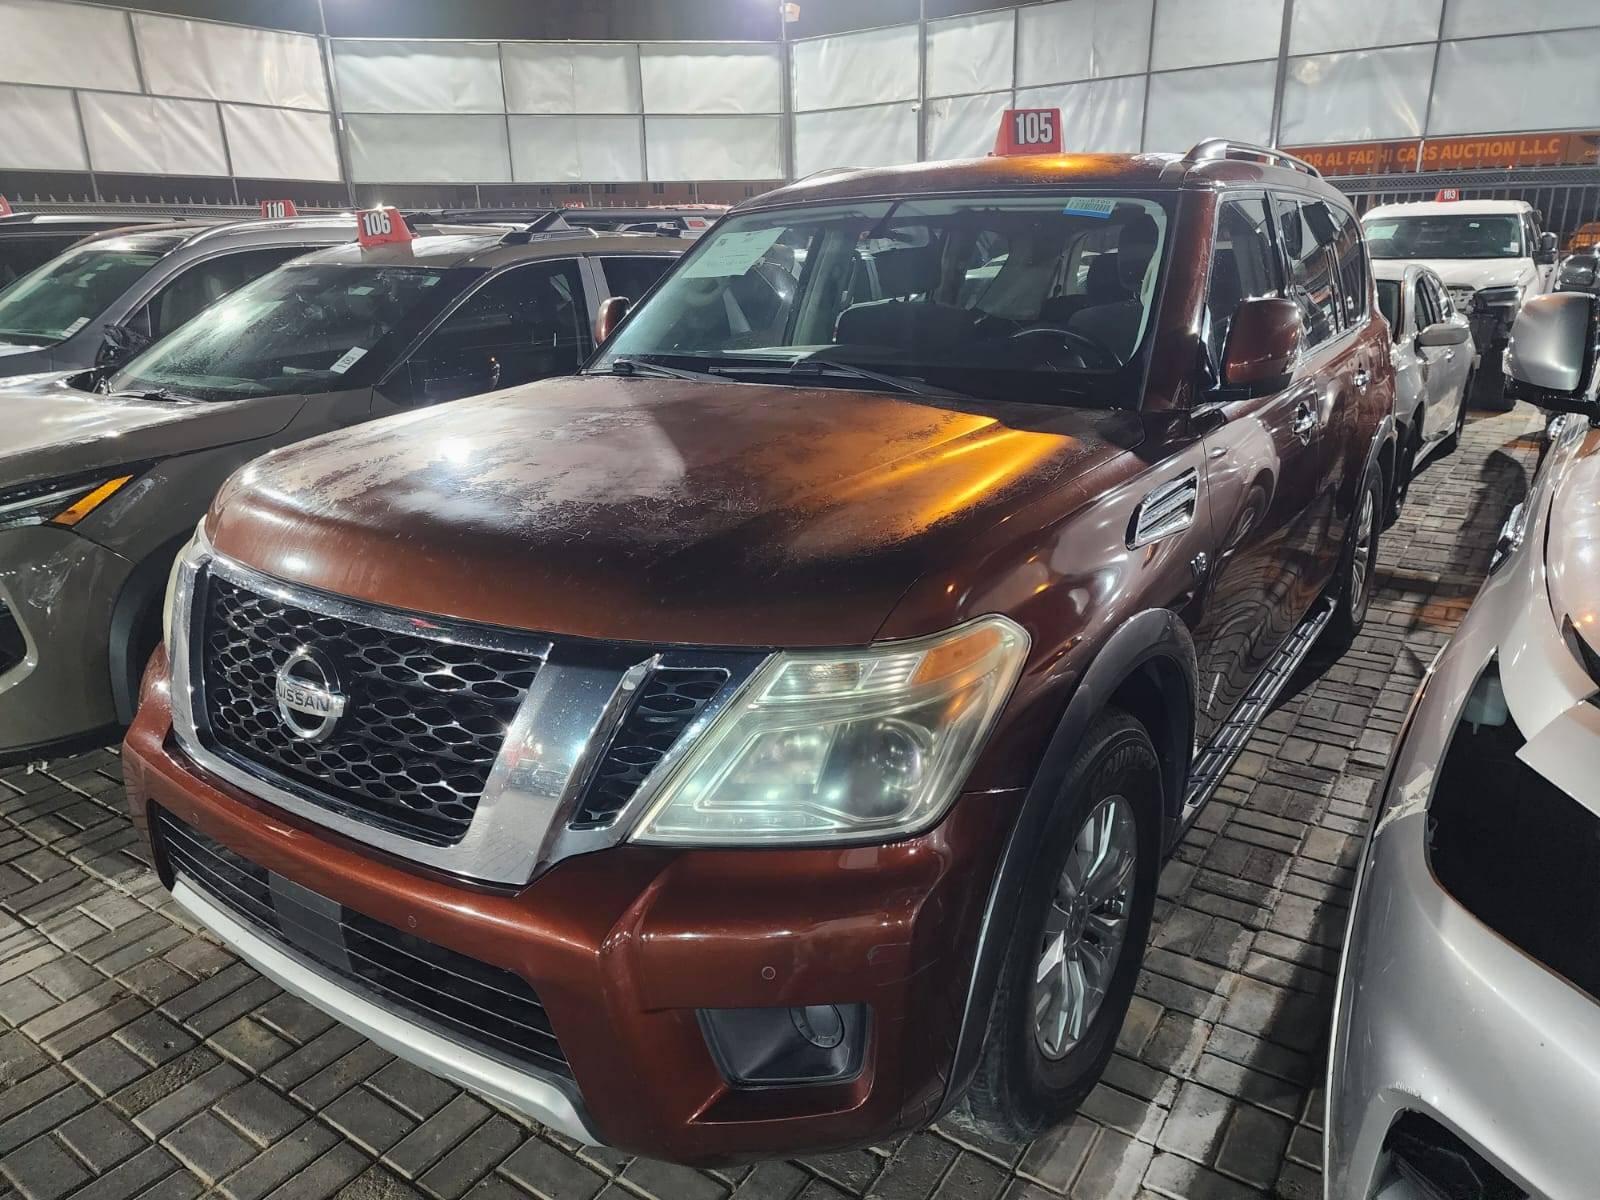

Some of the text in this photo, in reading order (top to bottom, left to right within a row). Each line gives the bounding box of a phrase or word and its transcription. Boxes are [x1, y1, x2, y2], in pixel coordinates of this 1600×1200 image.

[1016, 112, 1053, 145] 105
[1325, 151, 1344, 167] AL
[1440, 141, 1516, 160] AUCTION
[1519, 138, 1561, 156] L.L.C
[1443, 189, 1456, 200] 103
[266, 202, 286, 218] 110
[363, 212, 392, 237] 106
[278, 685, 331, 713] NISSAN
